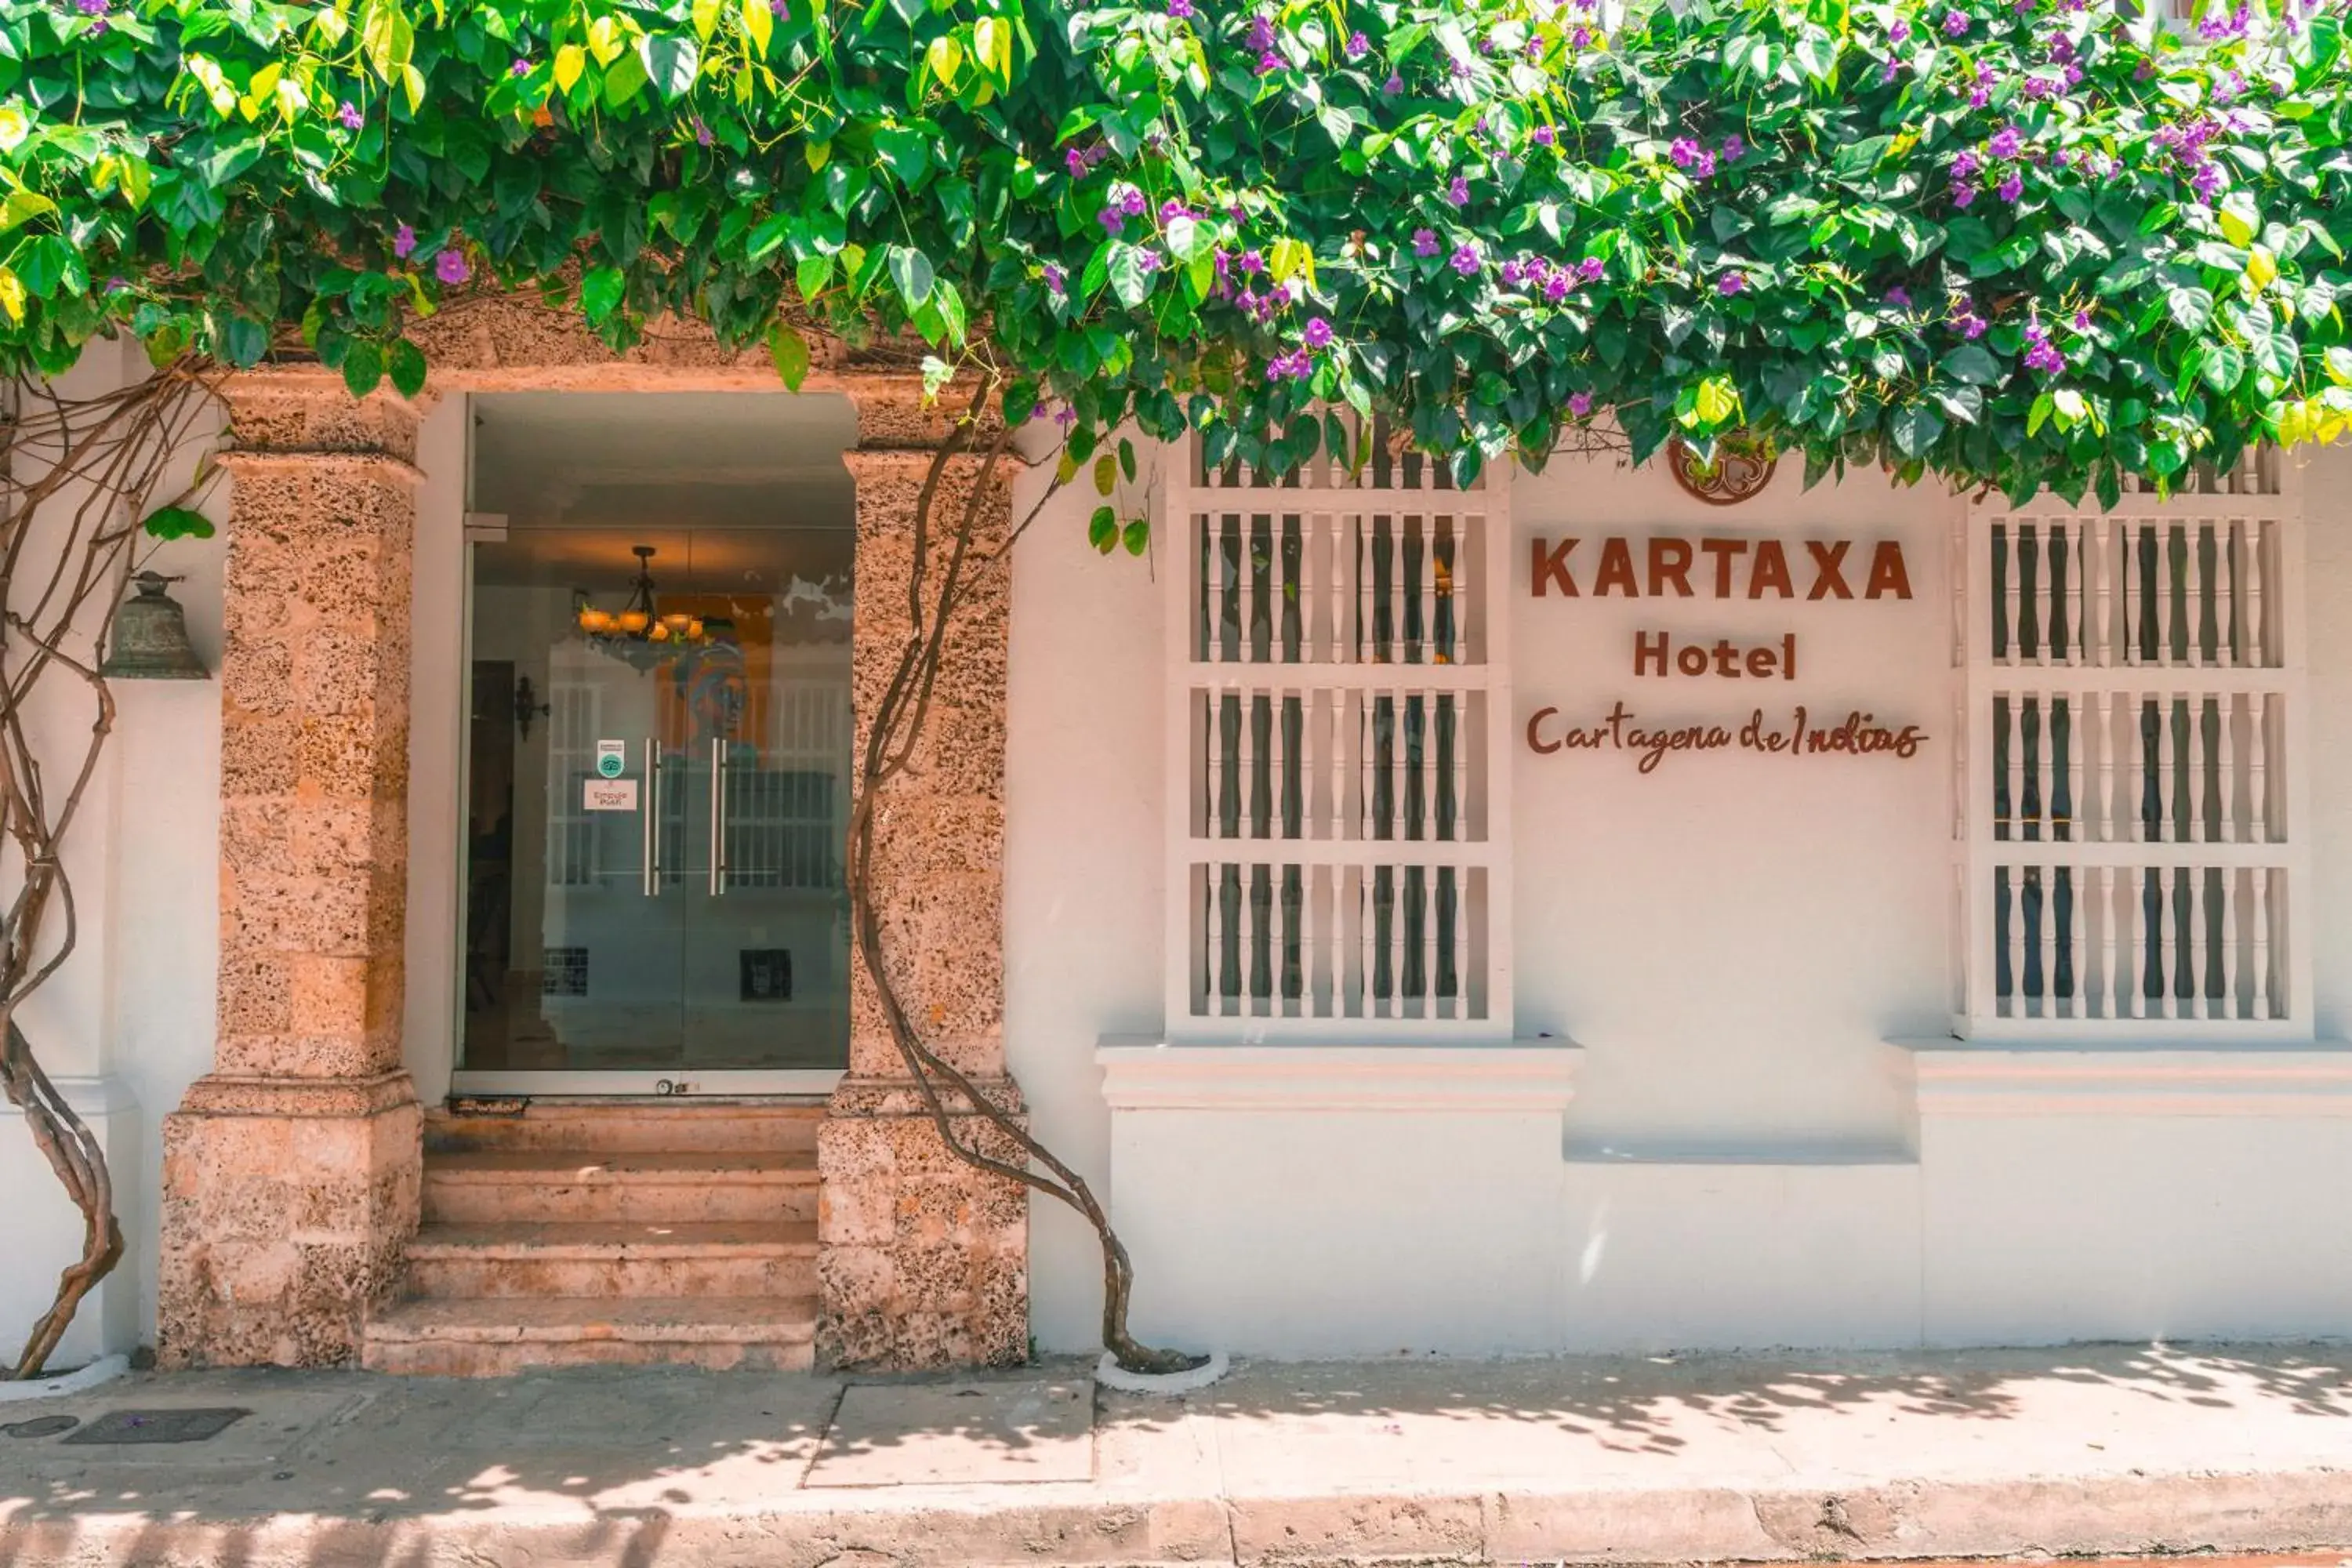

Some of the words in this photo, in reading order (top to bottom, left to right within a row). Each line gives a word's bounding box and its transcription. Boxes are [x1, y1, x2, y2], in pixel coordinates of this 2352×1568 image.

[1531, 537, 1913, 600] KARTAXA
[1635, 631, 1795, 680] Hotel
[1526, 701, 1731, 774] Cartagena
[1740, 708, 1790, 750] de
[1791, 706, 1929, 758] Indias
